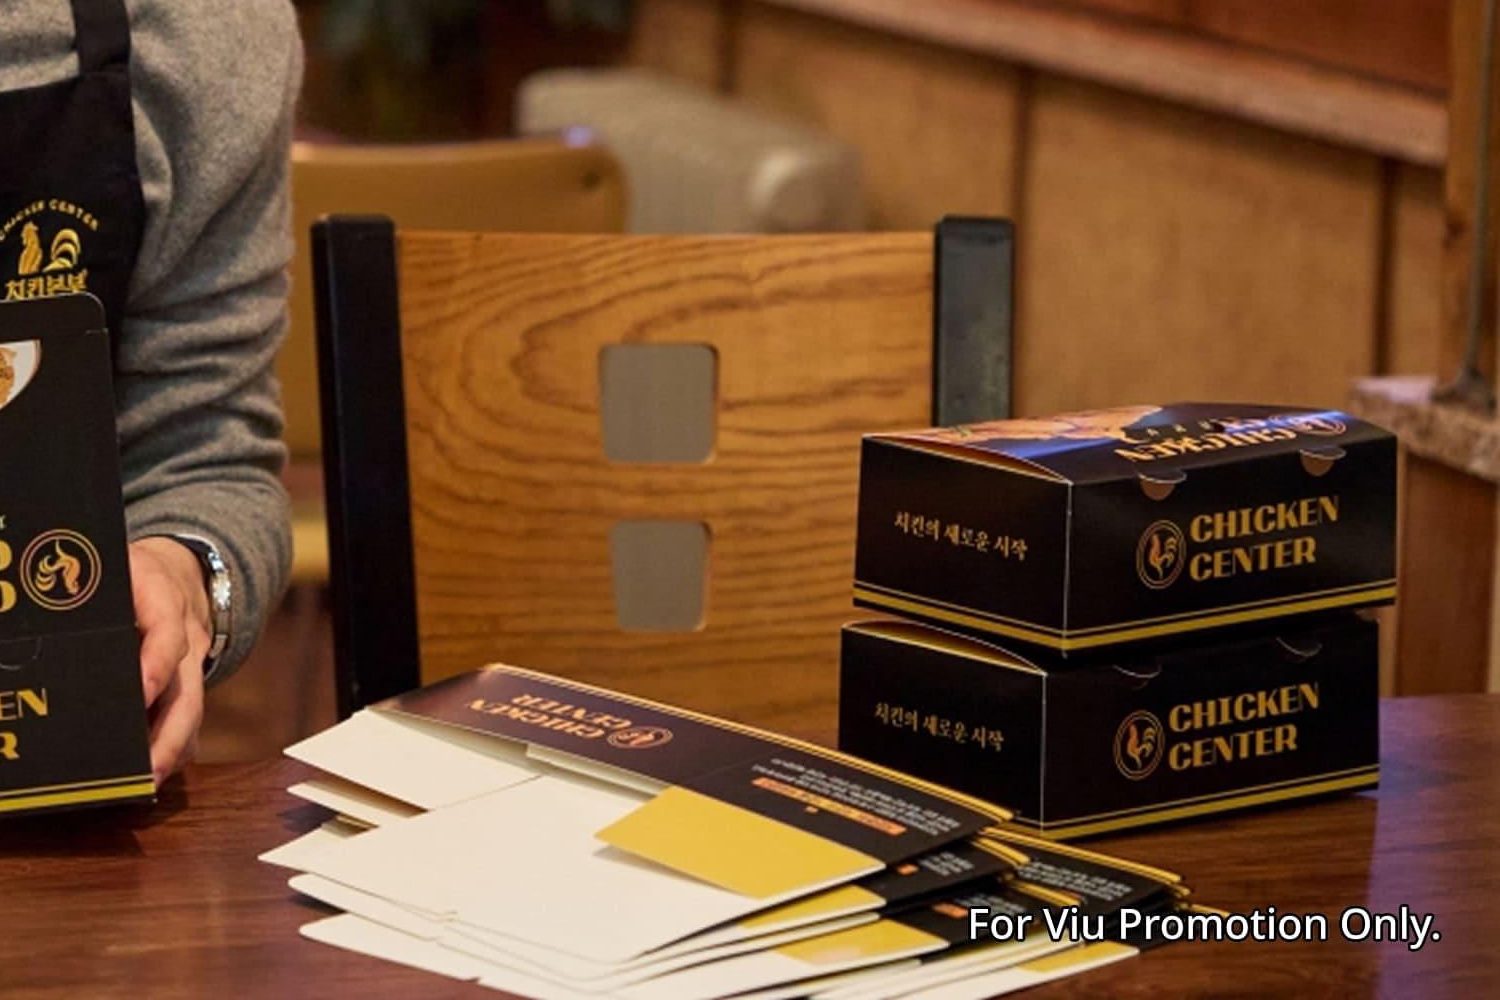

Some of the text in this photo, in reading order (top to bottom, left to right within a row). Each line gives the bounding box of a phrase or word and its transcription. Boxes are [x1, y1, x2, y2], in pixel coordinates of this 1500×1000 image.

[49, 199, 100, 231] CENTER
[894, 510, 1028, 561] 치킨의 새로운 시작
[1190, 494, 1339, 545] CHICKEN
[1189, 535, 1317, 581] CENTER
[466, 699, 605, 738] CHICKEN
[511, 694, 632, 729] CENTER
[874, 702, 1005, 752] 치킨의 새로운 시작
[1168, 682, 1320, 735] CHICKEN
[1167, 722, 1298, 771] CENTER
